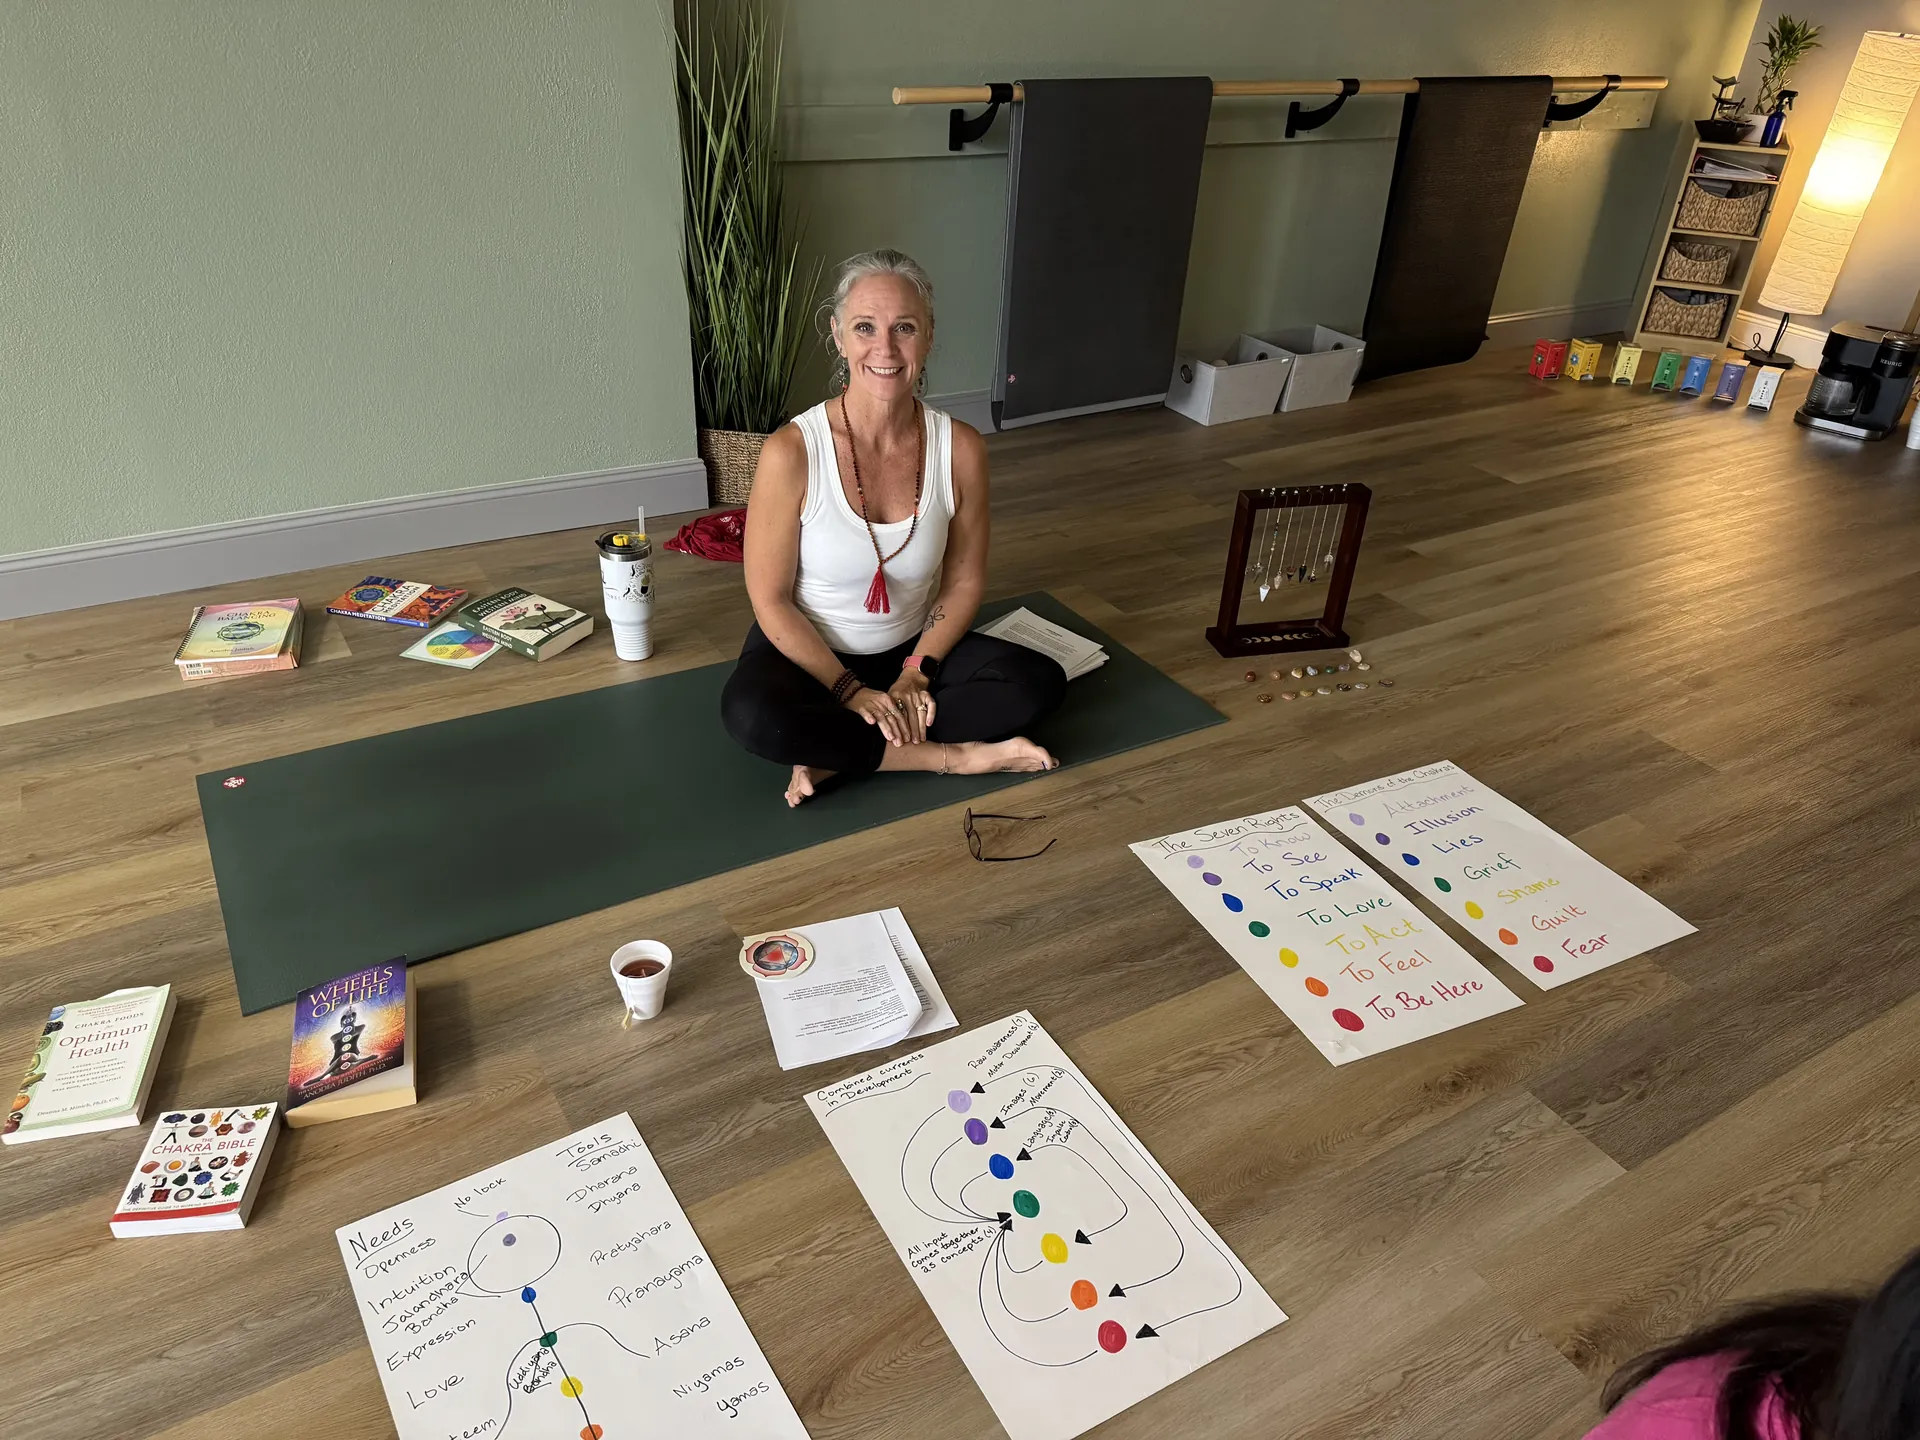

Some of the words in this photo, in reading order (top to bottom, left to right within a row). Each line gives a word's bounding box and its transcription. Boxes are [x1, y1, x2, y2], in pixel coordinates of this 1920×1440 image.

[1880, 359, 1902, 367] KEURIG
[372, 584, 412, 612] CHAKRA
[382, 586, 420, 613] MEDITATION
[472, 598, 500, 613] EASTERN
[501, 590, 518, 599] BODY
[478, 601, 508, 616] WESTERN
[508, 593, 526, 602] MIND
[352, 612, 386, 621] MEDITATION
[482, 632, 500, 643] WESTERN
[483, 626, 500, 636] EASTERN
[501, 633, 512, 642] BODY
[1314, 795, 1343, 809] The
[1339, 785, 1385, 801] Demons
[1398, 775, 1414, 785] the
[1413, 764, 1455, 779] Chakras
[1383, 785, 1475, 819] Attachment
[1152, 836, 1192, 854] The
[1194, 823, 1248, 843] Seven
[1243, 812, 1300, 830] Rights
[1404, 804, 1484, 836] Illusion
[1230, 842, 1259, 857] To
[1259, 832, 1312, 850] Know
[1432, 834, 1484, 853] Lies
[1243, 858, 1274, 874] To
[1282, 852, 1328, 866] See
[1464, 852, 1522, 879] Grief
[1264, 880, 1299, 900] To
[1299, 868, 1363, 892] Speak
[1497, 878, 1560, 904] Shame
[1297, 908, 1332, 925] To
[1334, 898, 1392, 917] Love
[1531, 904, 1587, 931] Guilt
[1325, 933, 1366, 954] To
[1362, 918, 1423, 946] Act
[1561, 933, 1610, 958] Fear
[1339, 962, 1375, 983] To
[1378, 950, 1432, 975] Feel
[309, 966, 393, 1006] WHEELS
[312, 997, 340, 1018] OF
[349, 981, 388, 1004] LIFE
[1366, 995, 1396, 1020] To
[1396, 991, 1433, 1011] Be
[1431, 979, 1483, 1002] Here
[59, 1024, 148, 1048] Optimum
[75, 1020, 111, 1029] CHAKRA
[115, 1012, 144, 1021] FOODS
[68, 1040, 129, 1060] Health
[967, 1056, 987, 1069] Raw
[817, 1074, 873, 1102] Combined
[879, 1053, 924, 1076] currents
[988, 1061, 1004, 1077] Motor
[303, 1083, 336, 1099] ANODEA
[826, 1099, 838, 1108] in
[840, 1068, 913, 1100] Development
[1000, 1089, 1027, 1115] Images
[1023, 1072, 1039, 1087] (6)
[37, 1107, 60, 1116] Deanna
[152, 1143, 212, 1154] CHAKRA
[217, 1138, 256, 1150] BIBLE
[556, 1133, 613, 1159] Tools
[1046, 1120, 1066, 1143] Impulse
[575, 1139, 641, 1172] Samadhi
[454, 1195, 471, 1208] No
[474, 1177, 507, 1196] lock
[566, 1164, 638, 1202] Dharana
[587, 1182, 641, 1214] Dhyana
[349, 1217, 414, 1261] Needs
[590, 1220, 672, 1266] Pratyahara
[908, 1245, 921, 1259] All
[923, 1232, 948, 1248] input
[912, 1250, 939, 1268] comes
[941, 1227, 979, 1250] together
[921, 1263, 936, 1273] as
[940, 1236, 984, 1263] concepts
[984, 1226, 996, 1238] (4)
[363, 1236, 437, 1279] Openness
[368, 1265, 457, 1314] Intuition
[608, 1253, 704, 1308] Pranayama
[382, 1271, 469, 1334] Jalandhara
[387, 1318, 476, 1372] Expression
[654, 1315, 711, 1356] Asana
[509, 1348, 549, 1389] Uddiyana
[672, 1356, 745, 1398] Niyamas
[406, 1374, 464, 1409] Love
